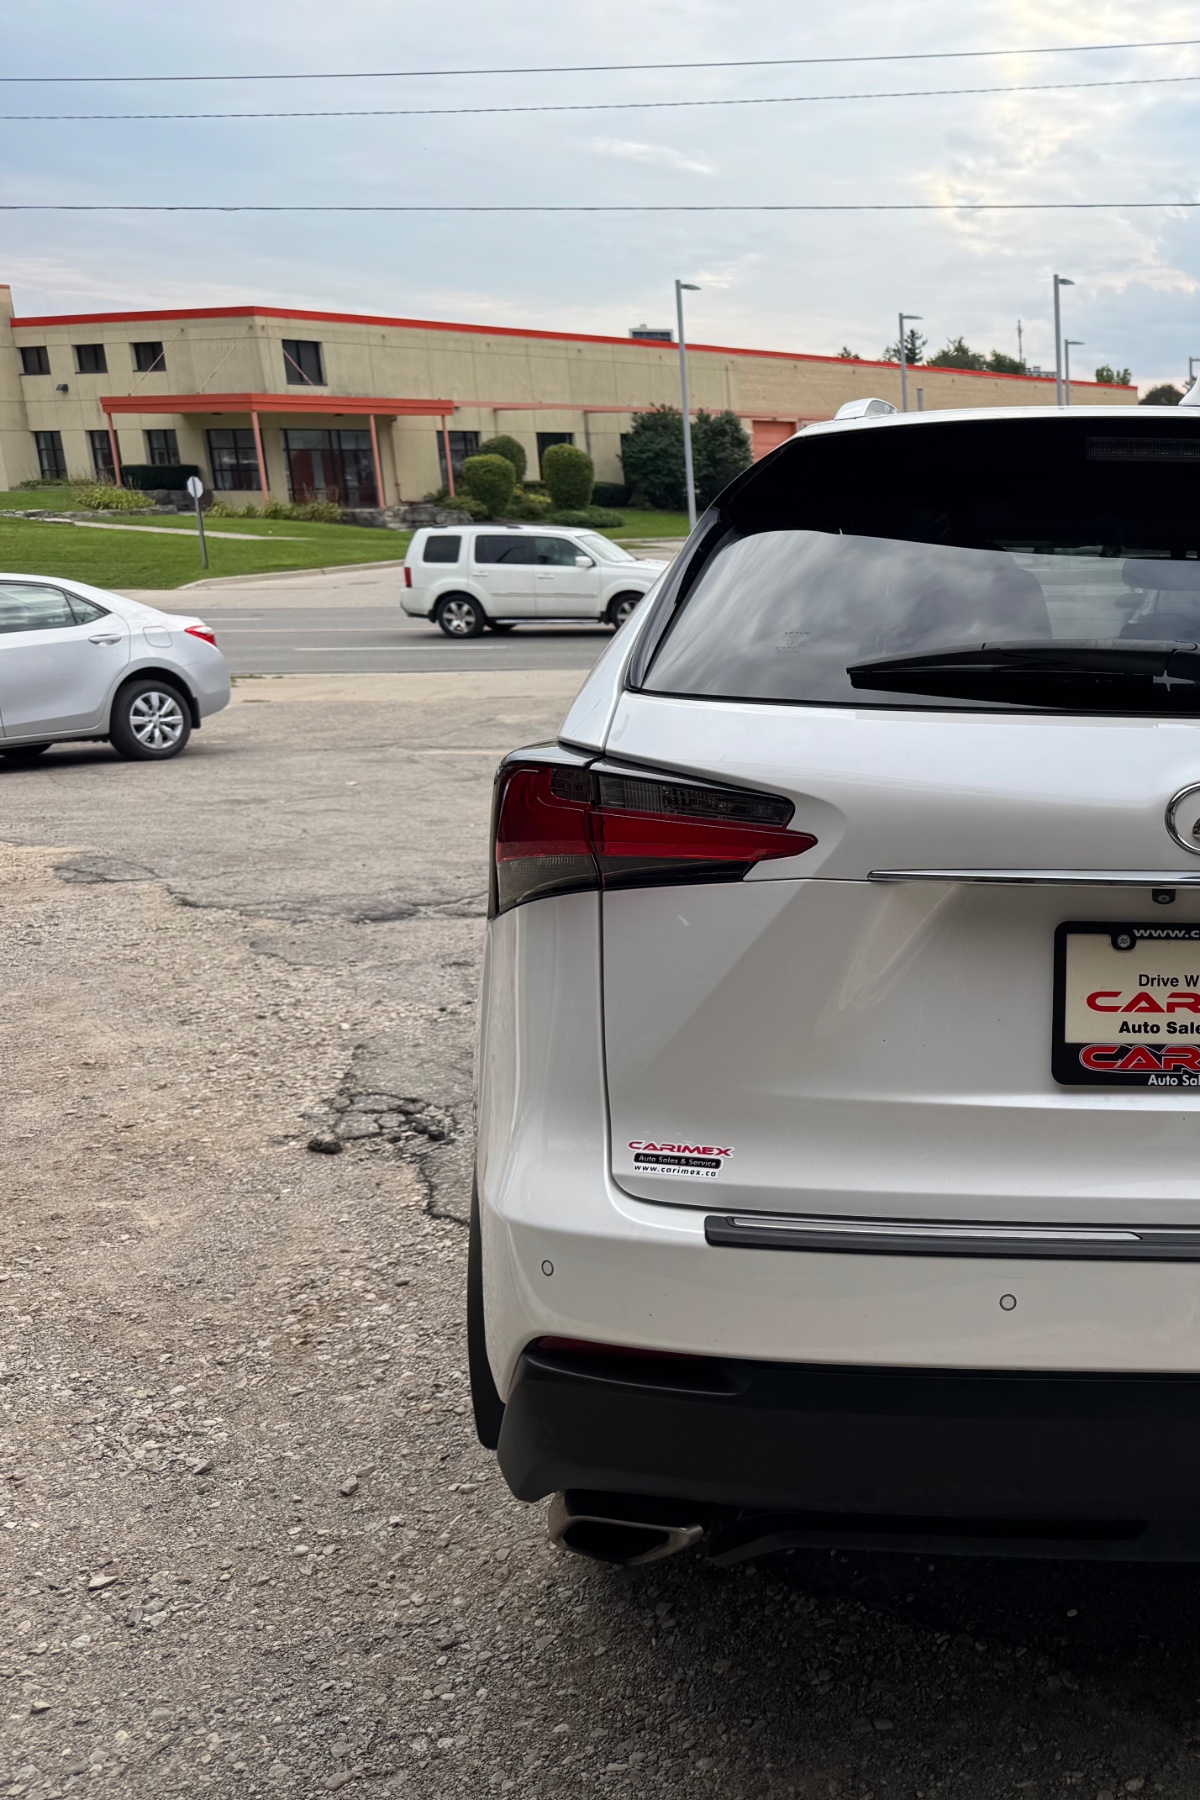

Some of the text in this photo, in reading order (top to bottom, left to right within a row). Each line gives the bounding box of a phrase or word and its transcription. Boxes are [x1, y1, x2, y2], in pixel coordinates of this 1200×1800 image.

[1138, 973, 1180, 988] Drive
[1119, 1021, 1161, 1035] Auto
[1147, 1074, 1180, 1087] Auto
[628, 1141, 733, 1157] CARIMEX
[638, 1154, 657, 1163] Auto
[658, 1156, 679, 1164] Sales
[688, 1158, 717, 1167] Service
[634, 1164, 717, 1177] www.carimex.ca
